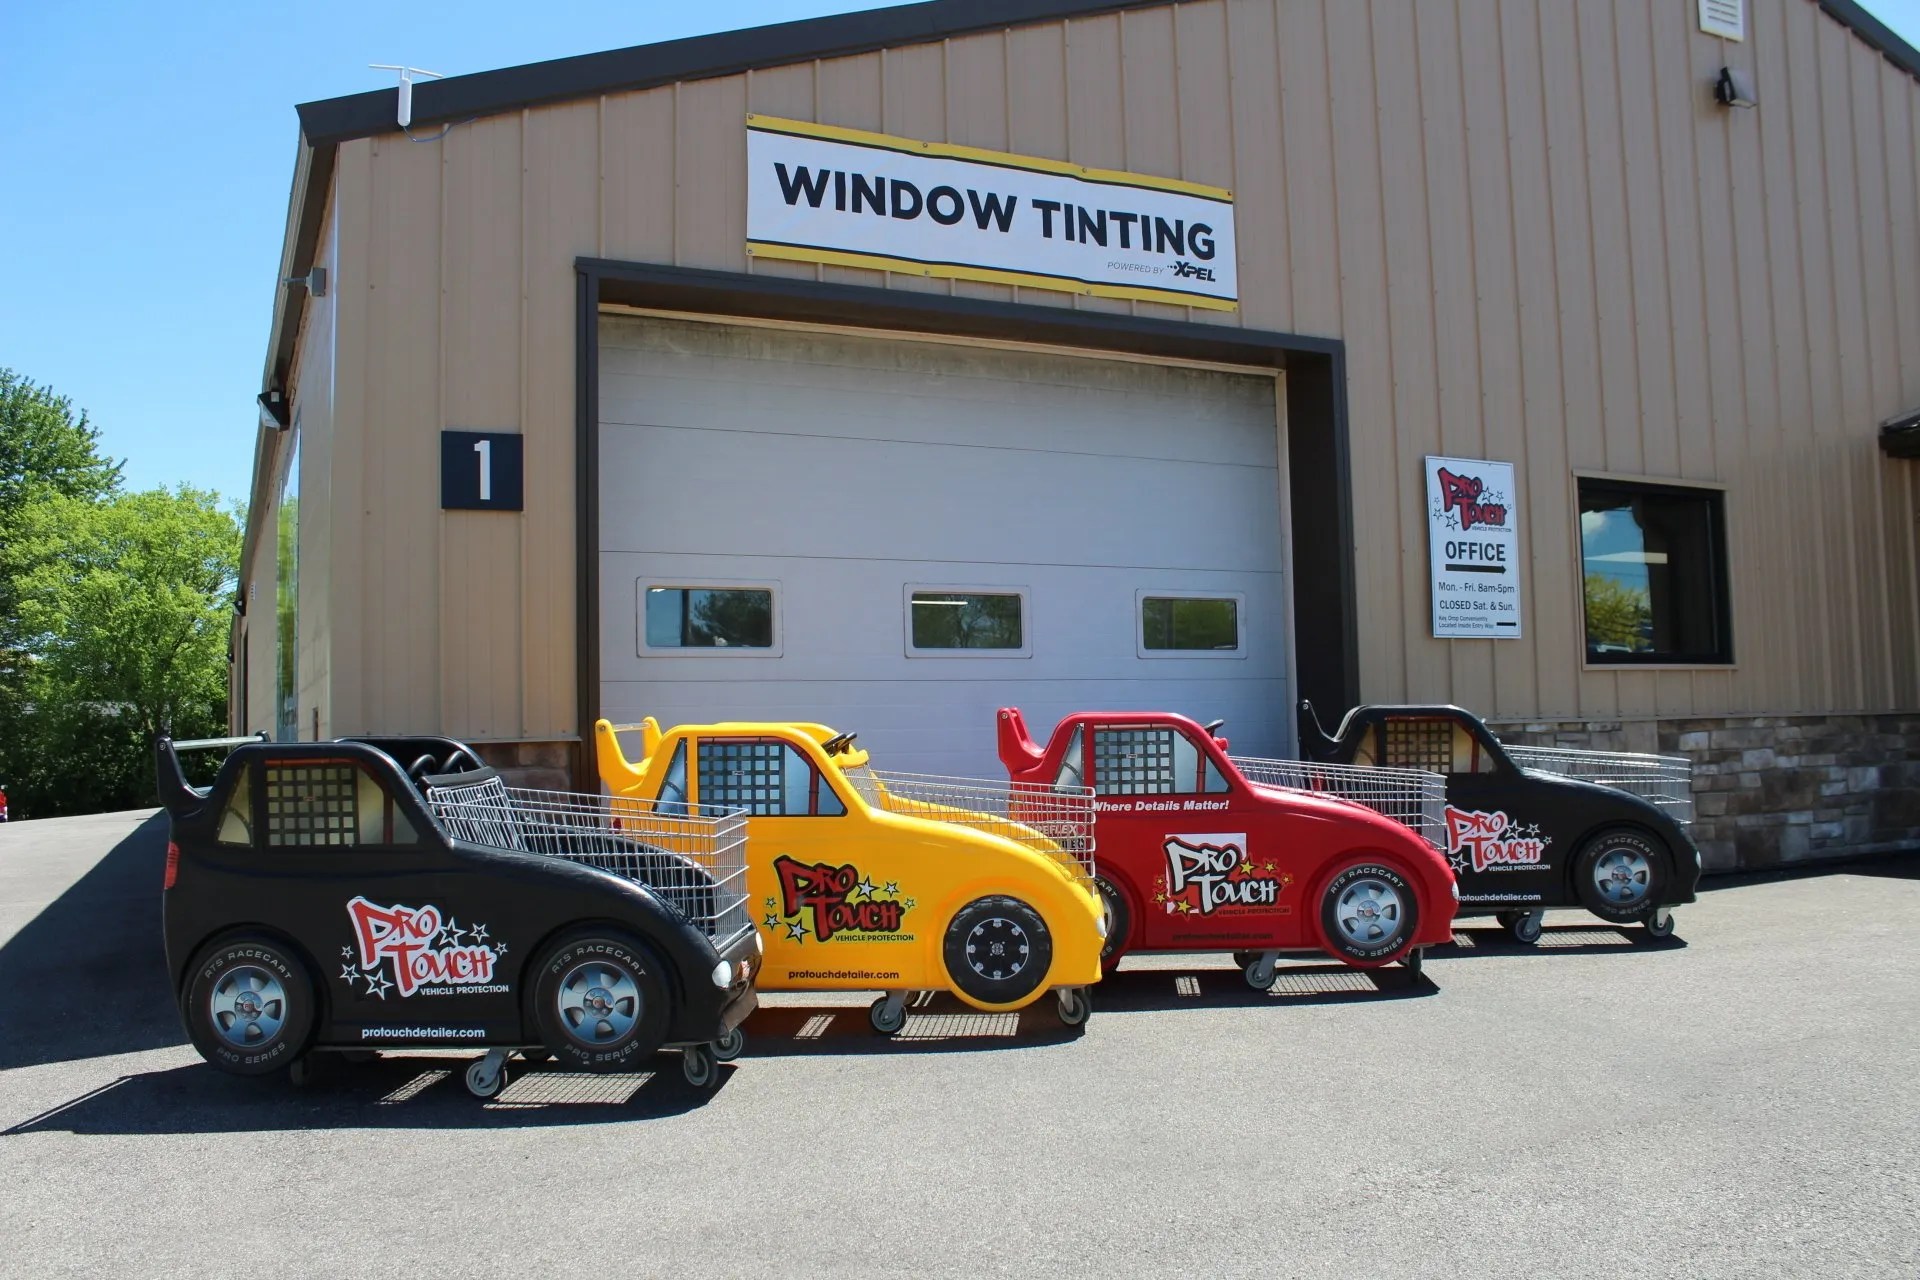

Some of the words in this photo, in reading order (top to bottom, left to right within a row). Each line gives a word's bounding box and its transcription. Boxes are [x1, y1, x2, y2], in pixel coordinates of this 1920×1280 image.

[773, 161, 1018, 233] WINDOW
[1031, 197, 1216, 260] TINTING
[1107, 261, 1151, 273] POWERED
[1153, 266, 1165, 274] BY
[1173, 260, 1216, 282] XPEL
[474, 440, 490, 500] 1
[1437, 467, 1483, 513] PRO
[1455, 497, 1507, 531] TOUCH
[1445, 541, 1506, 562] OFFICE
[1438, 582, 1458, 592] Mon.
[1464, 582, 1477, 592] Fri.
[1478, 583, 1515, 595] 8am-5pm
[1440, 600, 1471, 610] CLOSED
[1473, 601, 1488, 610] Sat.
[1490, 602, 1497, 611] &
[1498, 602, 1515, 611] Sun.
[1093, 801, 1132, 812] Where
[1135, 801, 1180, 811] Details
[1183, 800, 1230, 811] Matter!
[1444, 804, 1508, 855] PRO
[1163, 837, 1242, 895] PRO
[1463, 836, 1544, 873] TOUCH
[773, 855, 859, 918] PRO
[1349, 867, 1404, 888] RACECART
[1187, 874, 1281, 915] TOUCH
[1458, 893, 1541, 901] rotouchdetailer.com
[347, 895, 442, 970] PRO
[805, 895, 905, 942] TOUCH
[576, 945, 647, 976] RACECART
[1370, 936, 1403, 957] SERIES
[228, 949, 292, 979] RACECART
[381, 941, 497, 998] TOUCH
[788, 970, 899, 980] protouchdetailer.com
[420, 987, 454, 996] VEHICLE
[456, 985, 509, 995] PROTECTION
[362, 1027, 486, 1039] protouchdetailer.com
[245, 1042, 286, 1064] SERIES
[595, 1039, 639, 1062] SERIES
